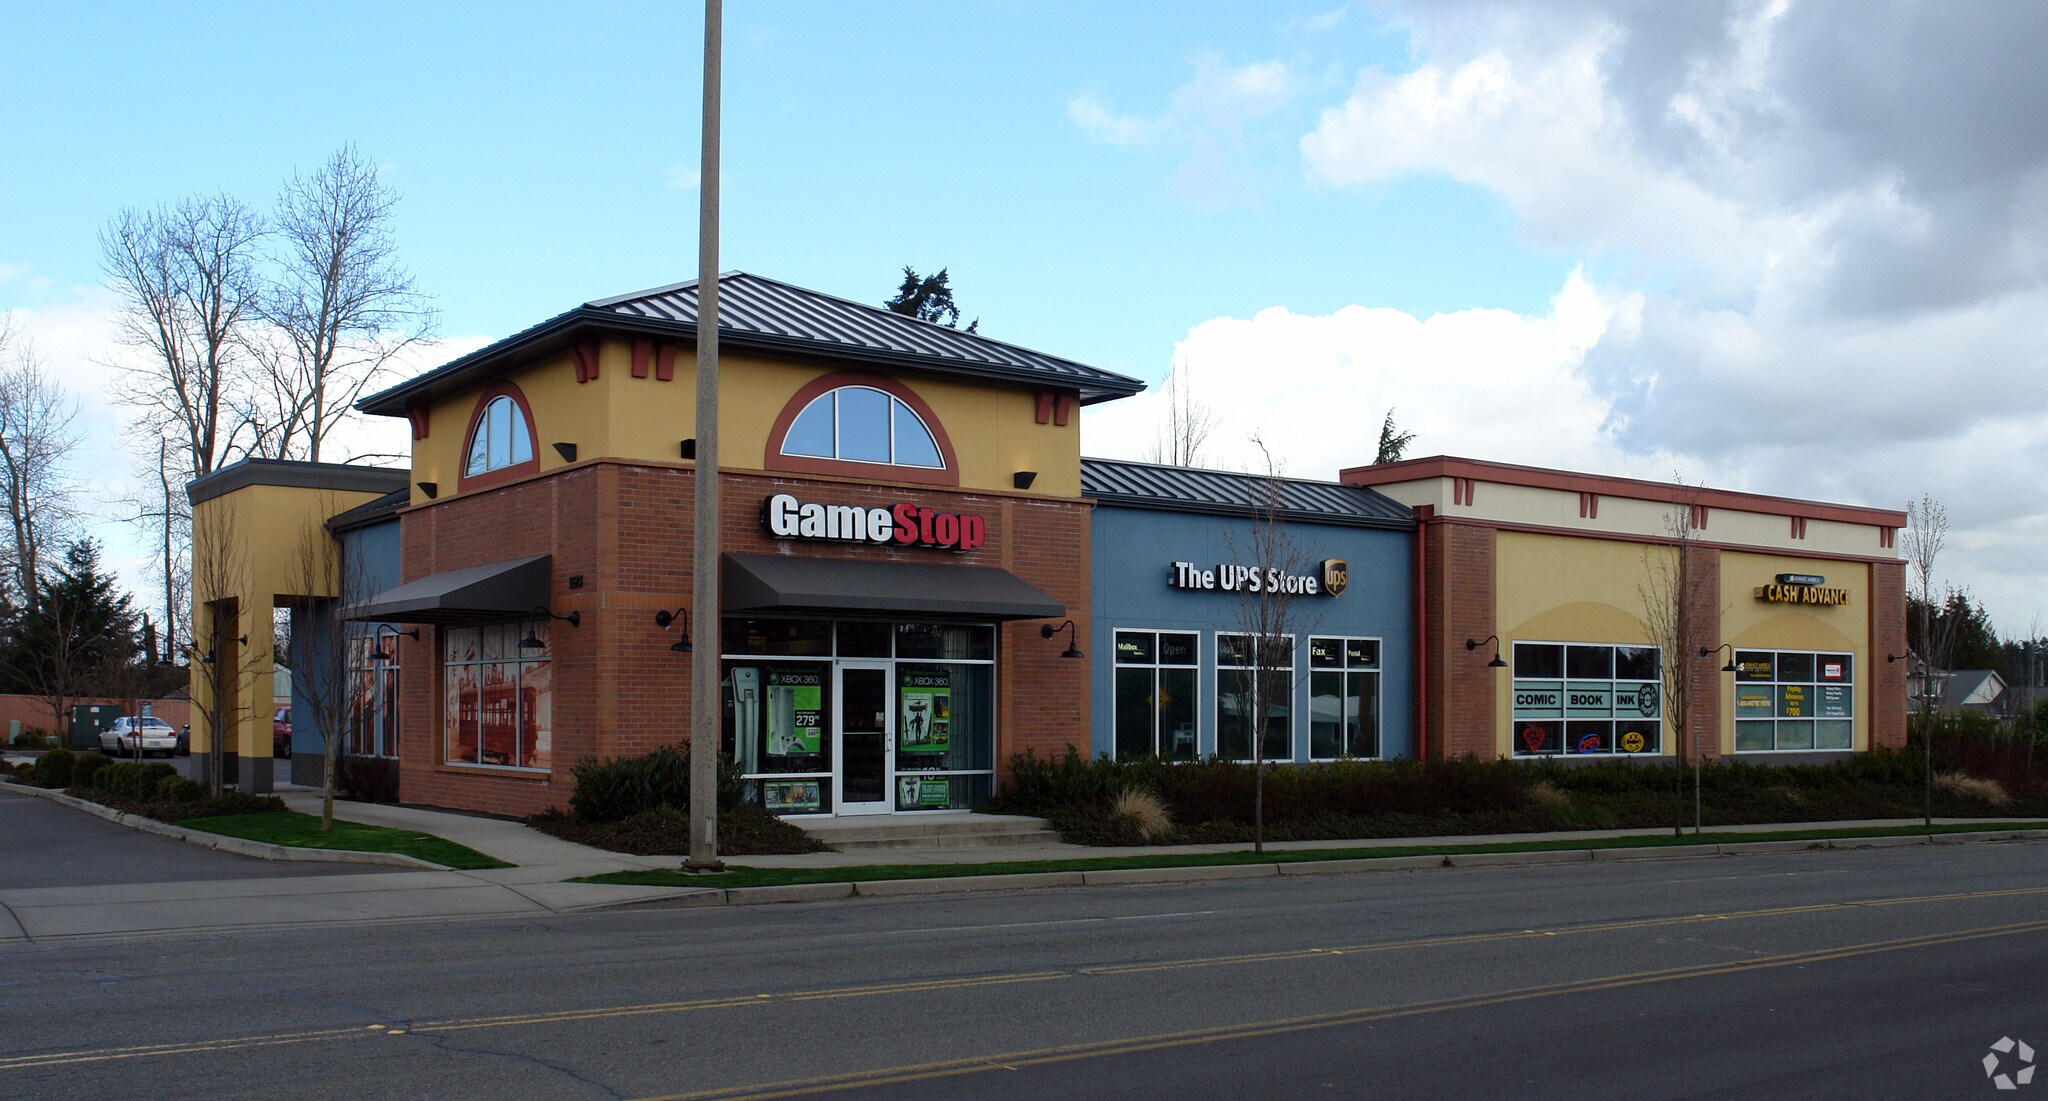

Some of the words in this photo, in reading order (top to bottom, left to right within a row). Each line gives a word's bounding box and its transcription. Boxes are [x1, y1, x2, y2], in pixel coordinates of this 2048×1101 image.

[771, 494, 985, 551] GameStop
[1175, 561, 1215, 590] The
[1220, 564, 1261, 593] UPS
[1266, 567, 1318, 596] Store
[1767, 584, 1798, 603] CASH
[1163, 642, 1187, 657] Open
[1312, 646, 1326, 656] Fax
[781, 674, 803, 684] XBOX
[803, 675, 819, 684] 360
[914, 676, 934, 686] XBOX
[934, 677, 949, 686] 360
[1516, 694, 1556, 705] COMIC
[1570, 695, 1604, 706] BOOK
[1617, 695, 1635, 705] INK
[1786, 707, 1800, 717] $700
[796, 714, 815, 727] 279
[1580, 736, 1601, 751] OPEN
